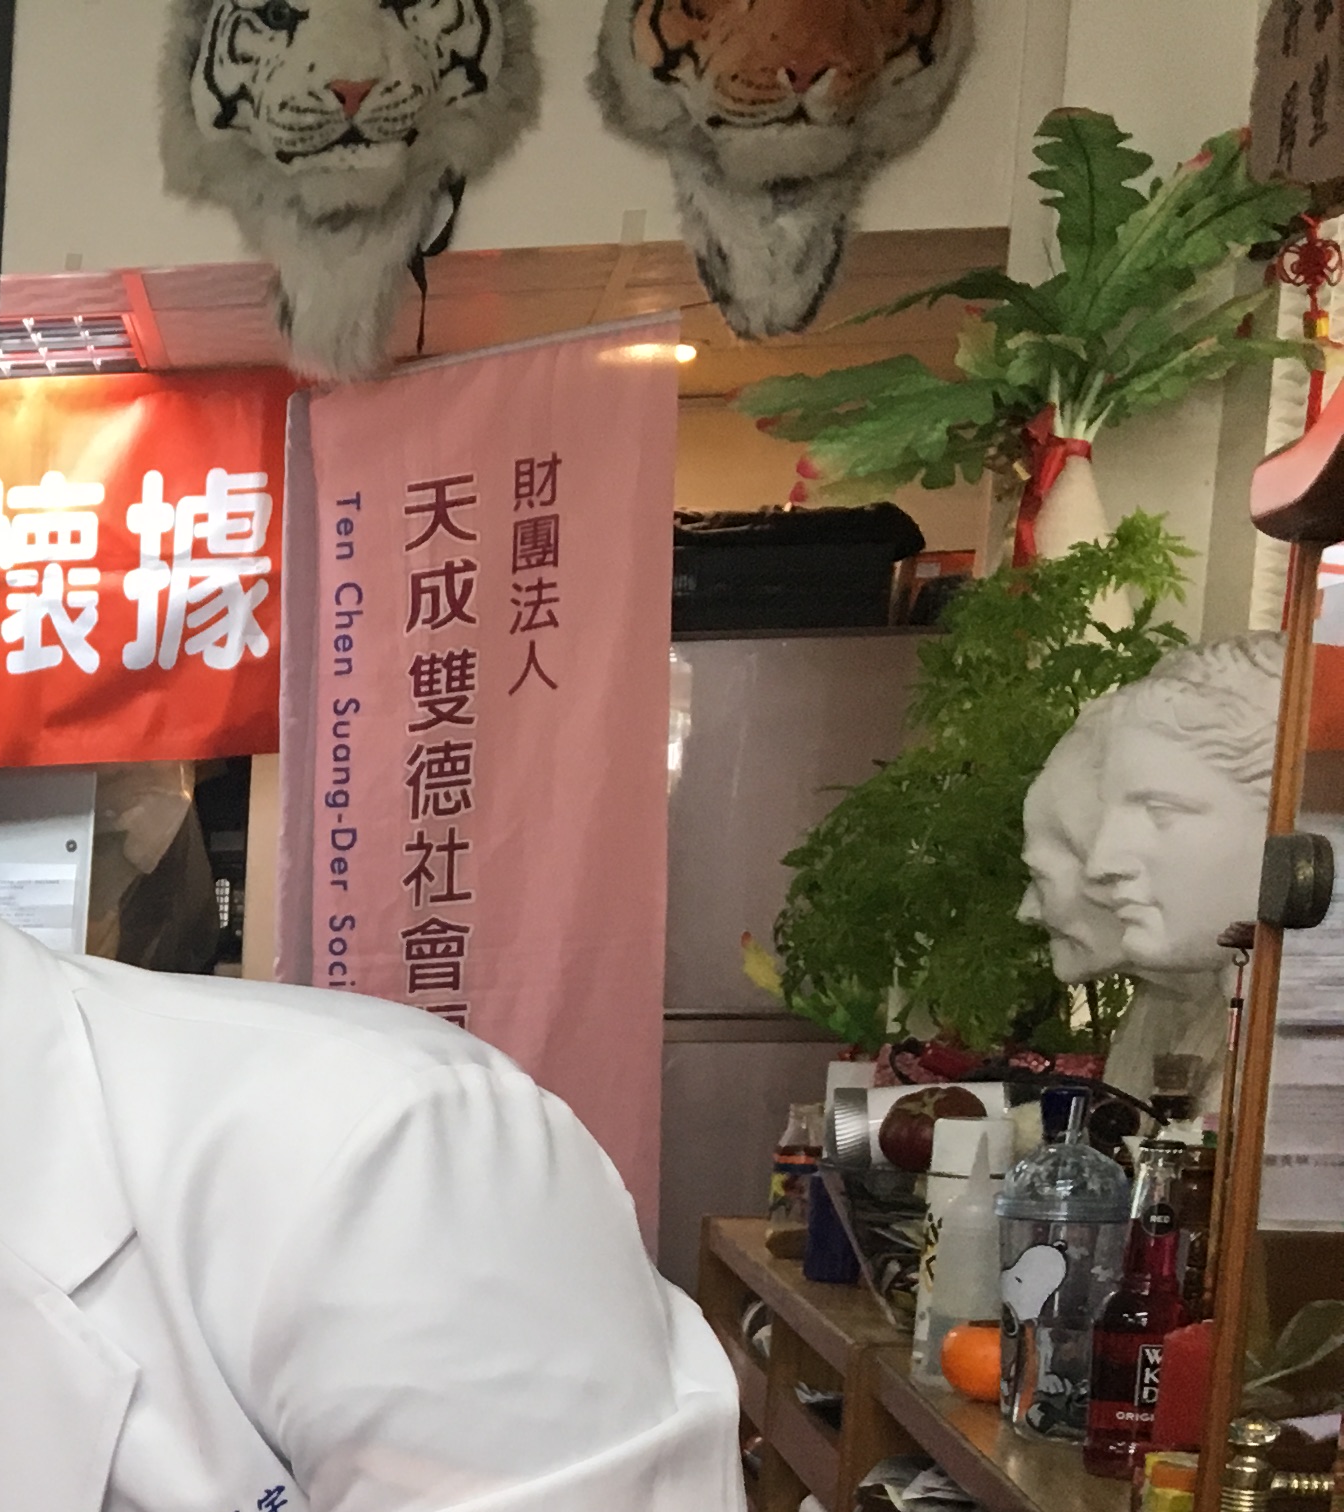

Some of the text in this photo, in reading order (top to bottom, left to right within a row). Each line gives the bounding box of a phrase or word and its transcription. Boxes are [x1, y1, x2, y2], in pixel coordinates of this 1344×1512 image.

[334, 491, 362, 561] Ten
[508, 452, 562, 696] 財團法人
[333, 582, 364, 677] Chen
[325, 698, 360, 892] Suang-Der
[401, 473, 478, 1030] 天成雙德社會
